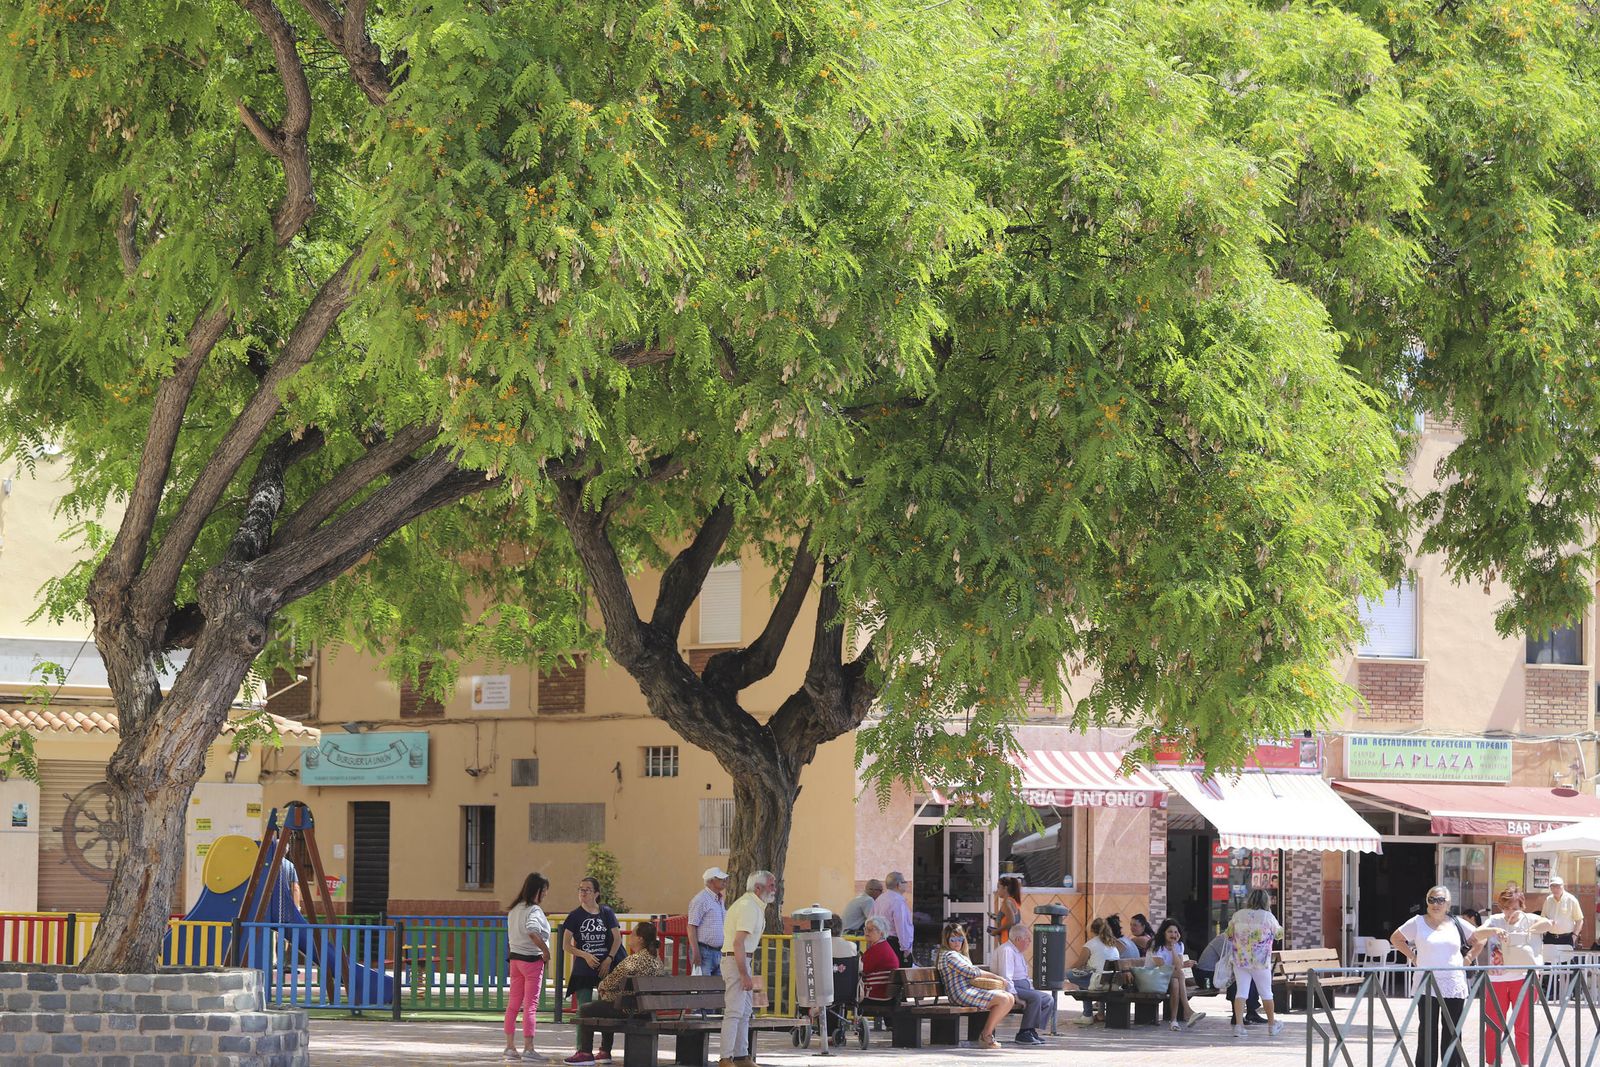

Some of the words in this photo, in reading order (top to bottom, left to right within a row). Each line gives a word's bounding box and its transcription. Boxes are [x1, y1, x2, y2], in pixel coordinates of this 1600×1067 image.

[1352, 737, 1368, 746] BAR
[1372, 738, 1427, 748] RESTAURANTE
[1431, 740, 1472, 749] CAFETERIA
[1476, 741, 1508, 750] TAPERIA
[1382, 752, 1405, 768] LA
[1412, 753, 1474, 769] PLAZA
[1071, 791, 1146, 806] ANTONIO
[1507, 821, 1531, 835] BAR
[581, 932, 606, 941] Move
